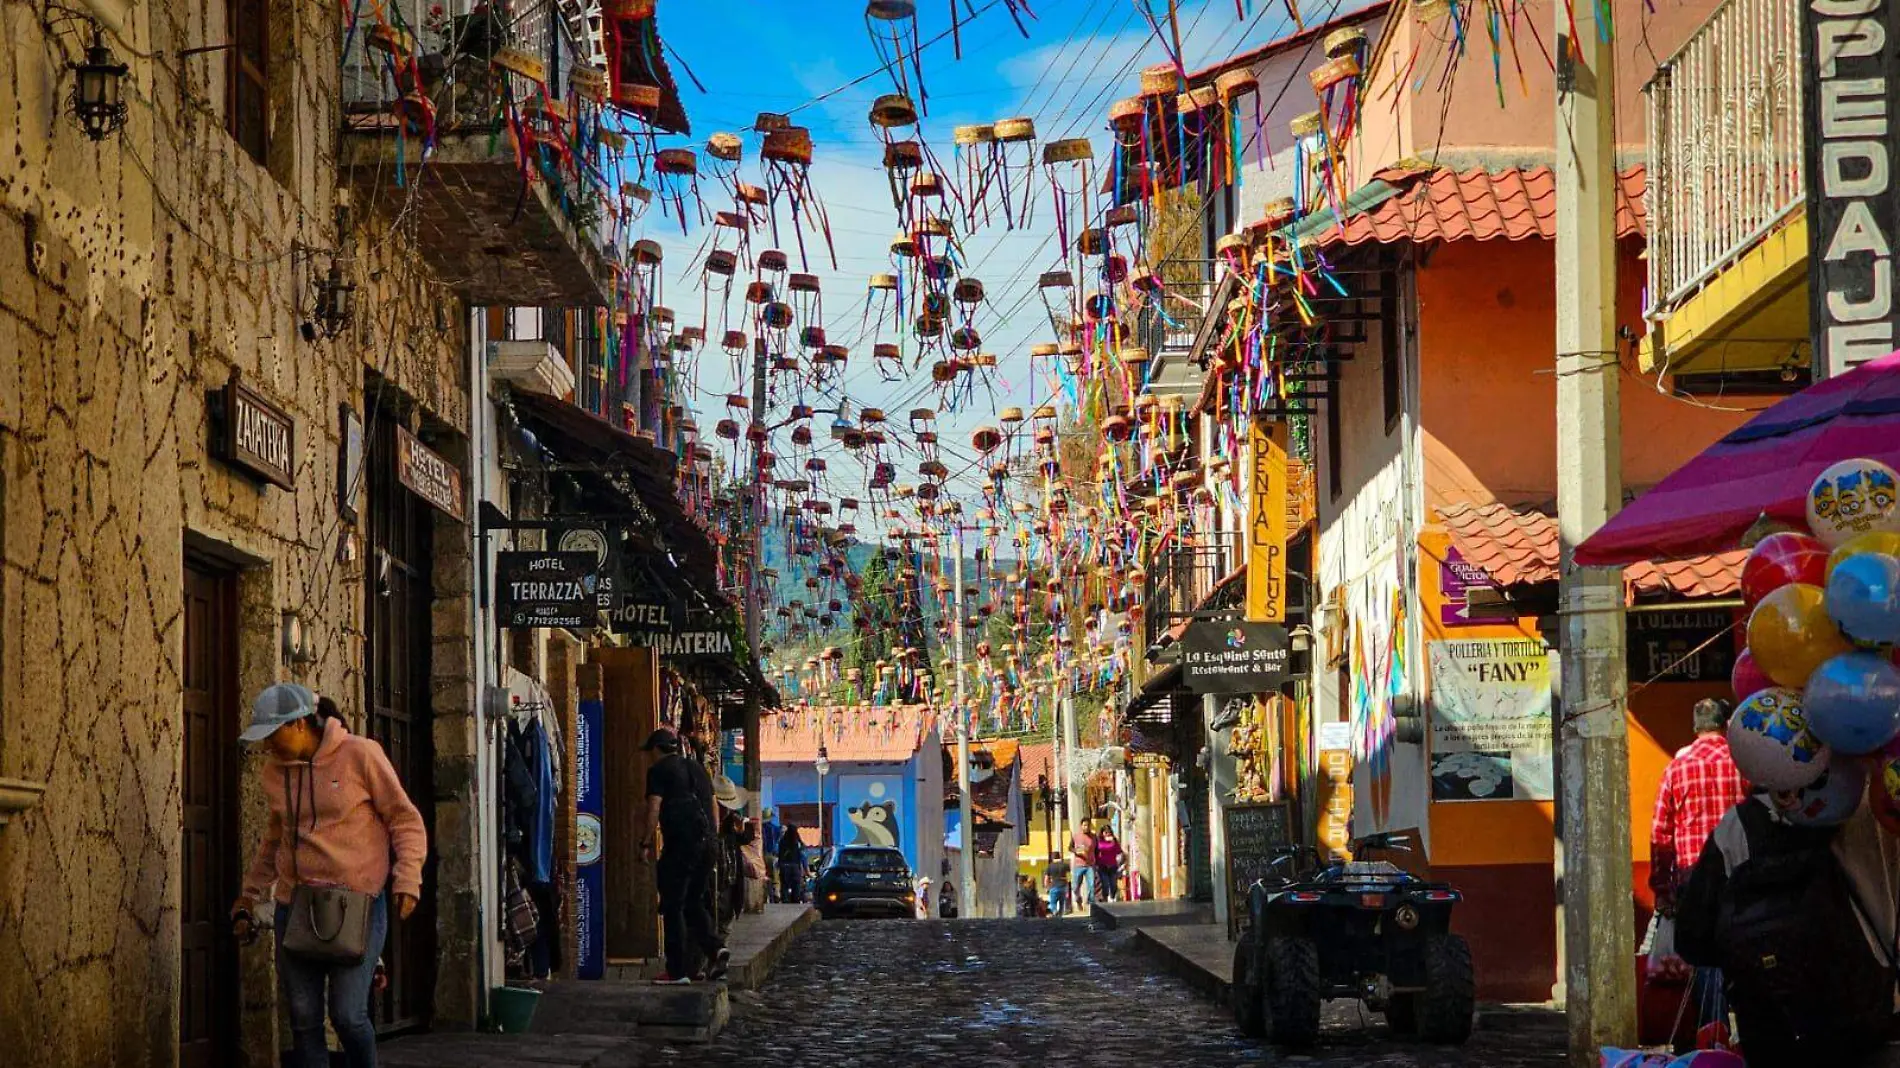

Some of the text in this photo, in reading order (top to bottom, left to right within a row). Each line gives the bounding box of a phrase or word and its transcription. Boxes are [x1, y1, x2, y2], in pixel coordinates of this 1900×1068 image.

[1809, 0, 1895, 378] PEDAJE
[410, 439, 450, 486] HOTEL
[1254, 438, 1269, 546] DENTAL
[528, 558, 566, 571] HOTEL
[511, 581, 584, 600] TERRAZZA
[1266, 545, 1280, 618] PLUS
[613, 603, 670, 625] HOTEL
[1203, 650, 1250, 664] Esquina
[1252, 648, 1287, 661] Santa
[1493, 642, 1500, 658] Y
[1646, 641, 1701, 679] Fany
[1252, 663, 1262, 673] &
[1264, 662, 1282, 673] Bar
